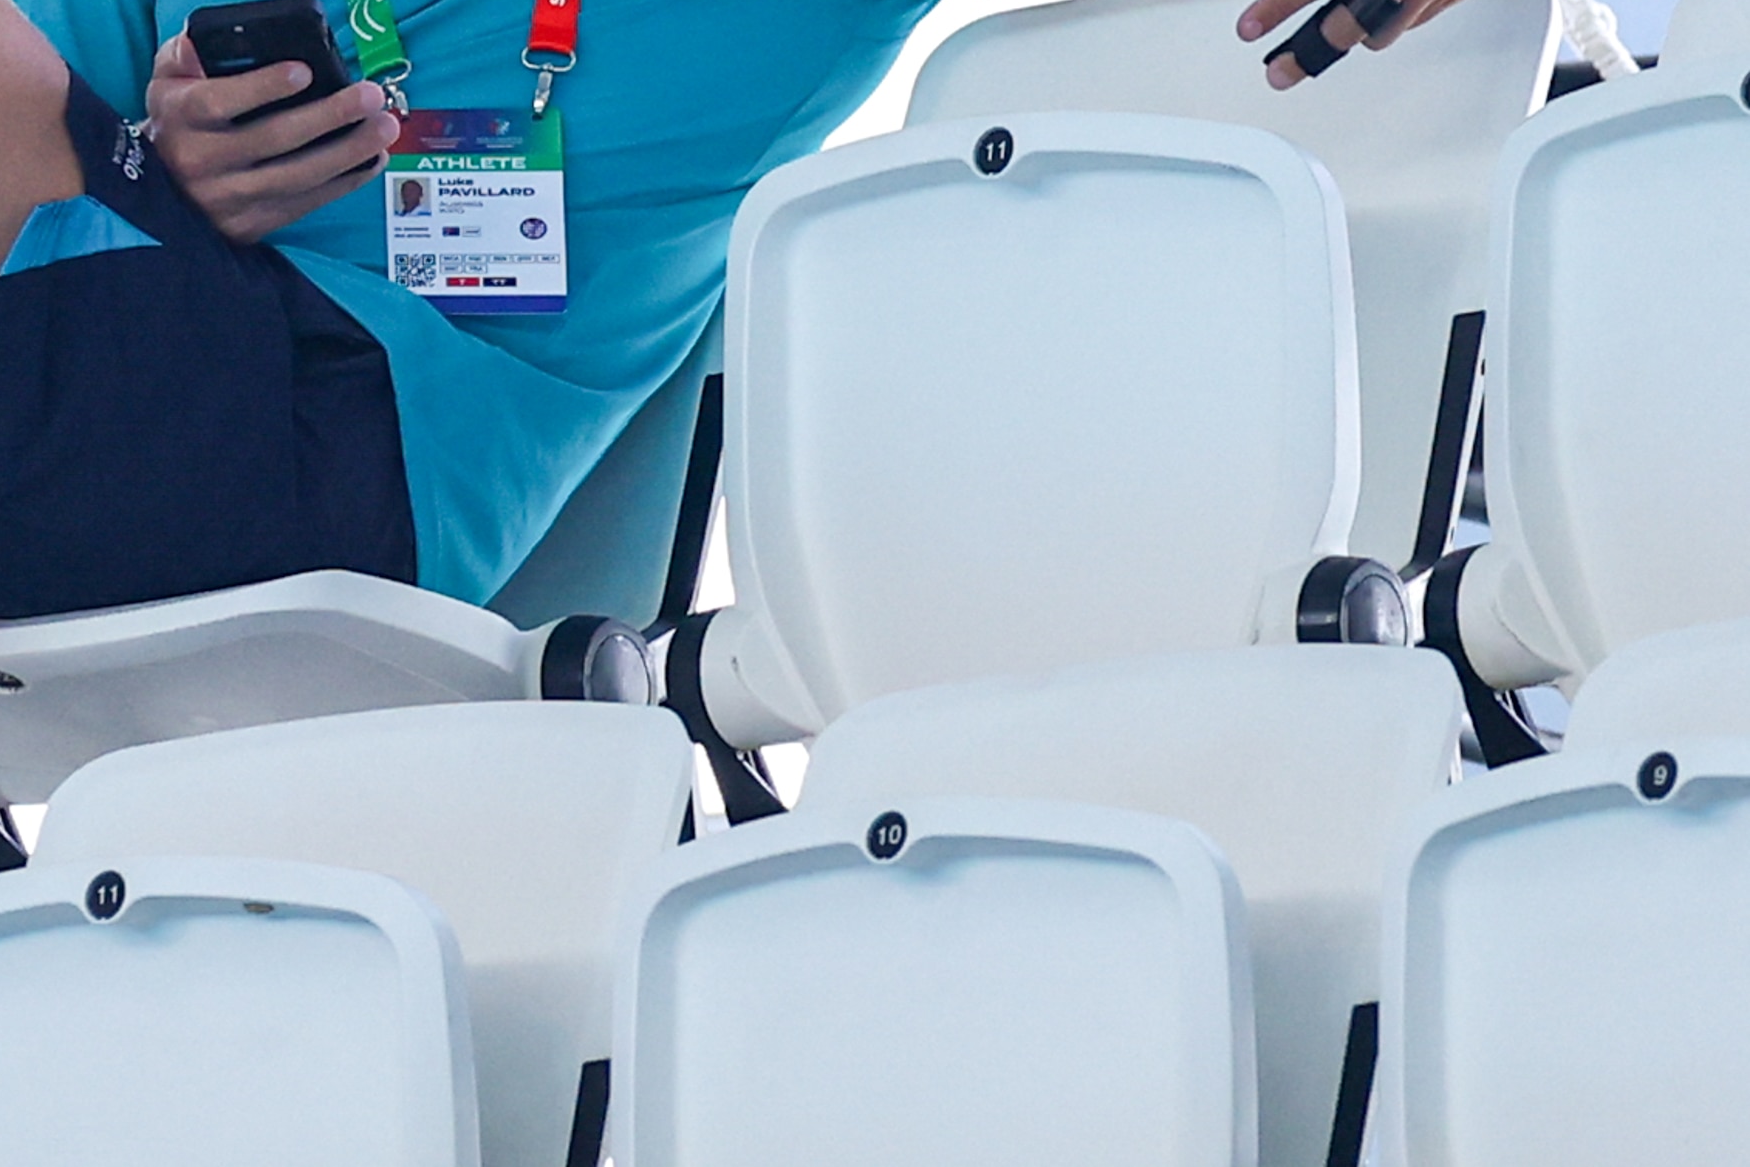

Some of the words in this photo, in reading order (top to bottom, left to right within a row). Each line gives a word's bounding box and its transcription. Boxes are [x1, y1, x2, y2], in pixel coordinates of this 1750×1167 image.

[984, 140, 1007, 161] 11
[417, 156, 526, 170] ATHLETE
[438, 178, 474, 186] Luke
[438, 187, 535, 197] PAVILLARD
[1653, 765, 1667, 786] 9
[877, 824, 900, 845] 10
[96, 885, 118, 905] 11
